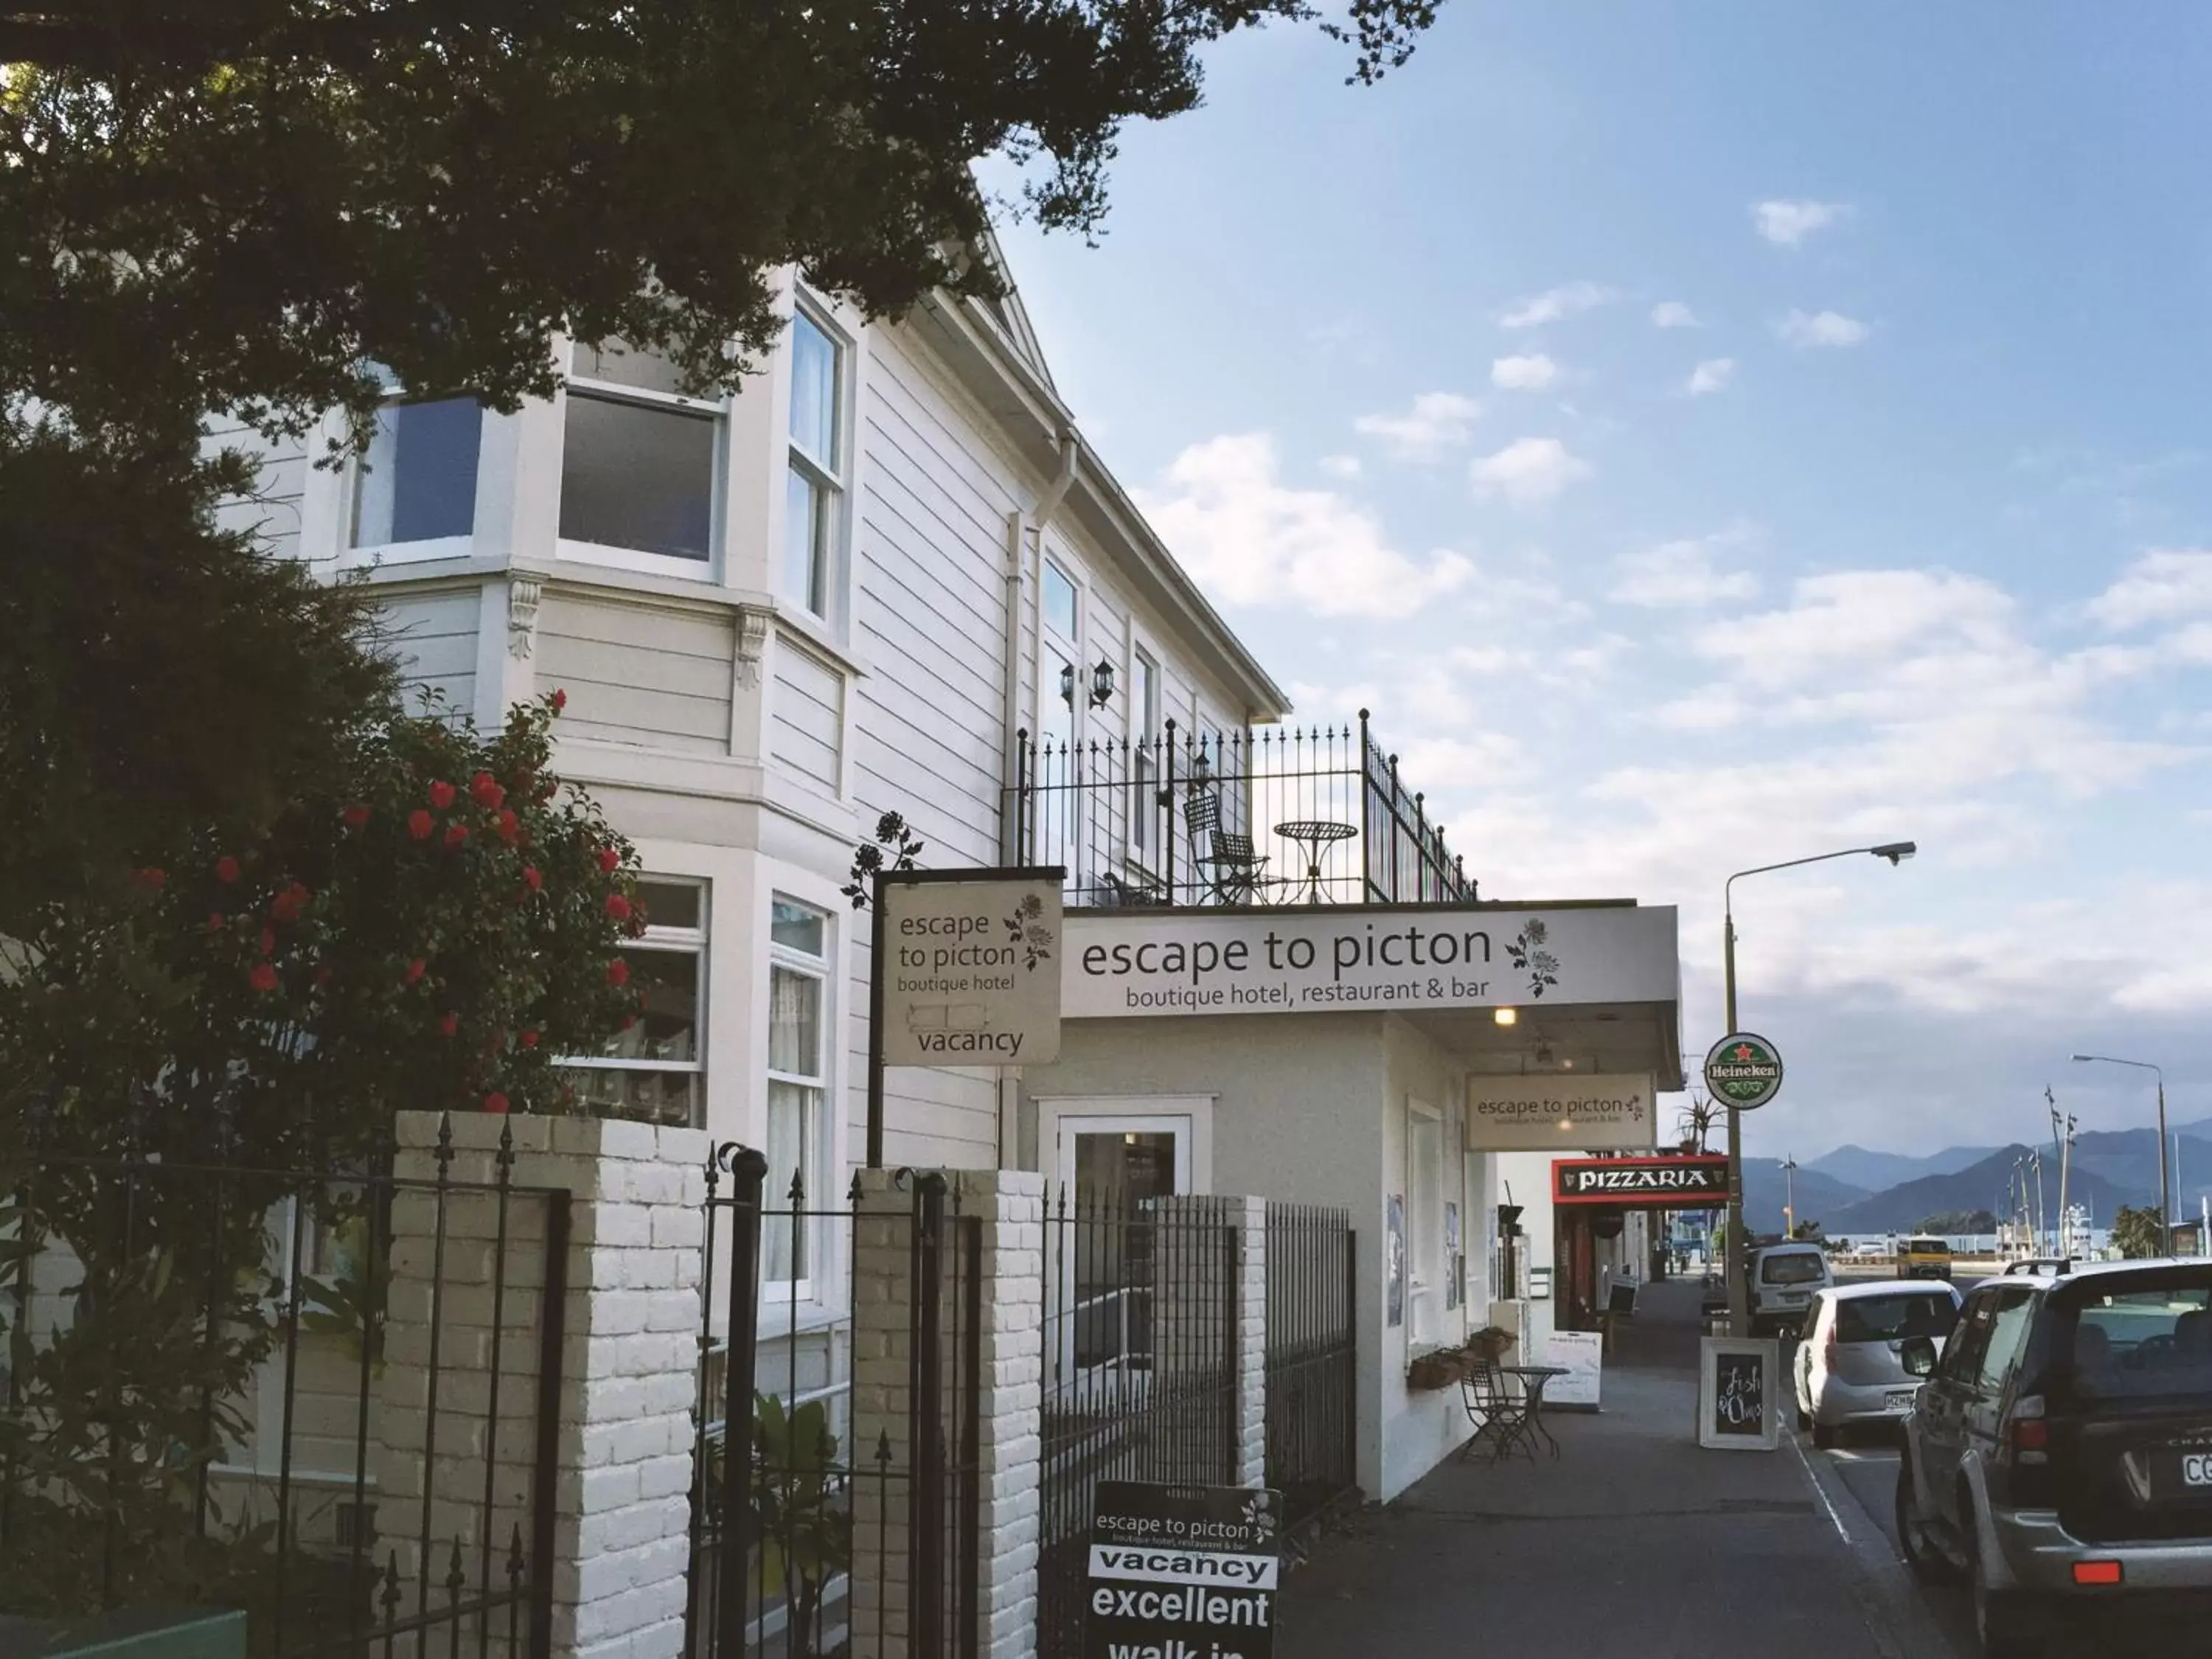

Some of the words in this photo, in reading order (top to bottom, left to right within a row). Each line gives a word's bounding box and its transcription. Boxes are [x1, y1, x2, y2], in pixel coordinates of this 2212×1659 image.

[900, 916, 990, 941] escape
[898, 945, 925, 967] to
[934, 943, 1015, 973] picton
[1082, 939, 1249, 985] escape
[1263, 931, 1315, 970] to
[1334, 923, 1490, 981] picton
[897, 976, 968, 995] boutique
[973, 973, 1015, 991] hotel
[1126, 986, 1223, 1012] boutique
[1231, 981, 1295, 1008] hotel,
[1302, 981, 1420, 1002] restaurant
[1426, 978, 1444, 998] &
[1451, 975, 1489, 998] bar
[917, 1032, 1024, 1057] vacancy
[1712, 1064, 1776, 1078] Heineken
[1478, 1099, 1538, 1118] escape
[1543, 1098, 1562, 1113] to
[1567, 1096, 1623, 1119] picton
[1578, 1166, 1708, 1192] PIZZARIA
[1096, 1514, 1161, 1537] escape
[1166, 1517, 1186, 1534] to
[1190, 1519, 1249, 1539] picton
[1099, 1551, 1269, 1584] vacancy
[1092, 1586, 1270, 1627] excellent
[1211, 1642, 1245, 1659] i
